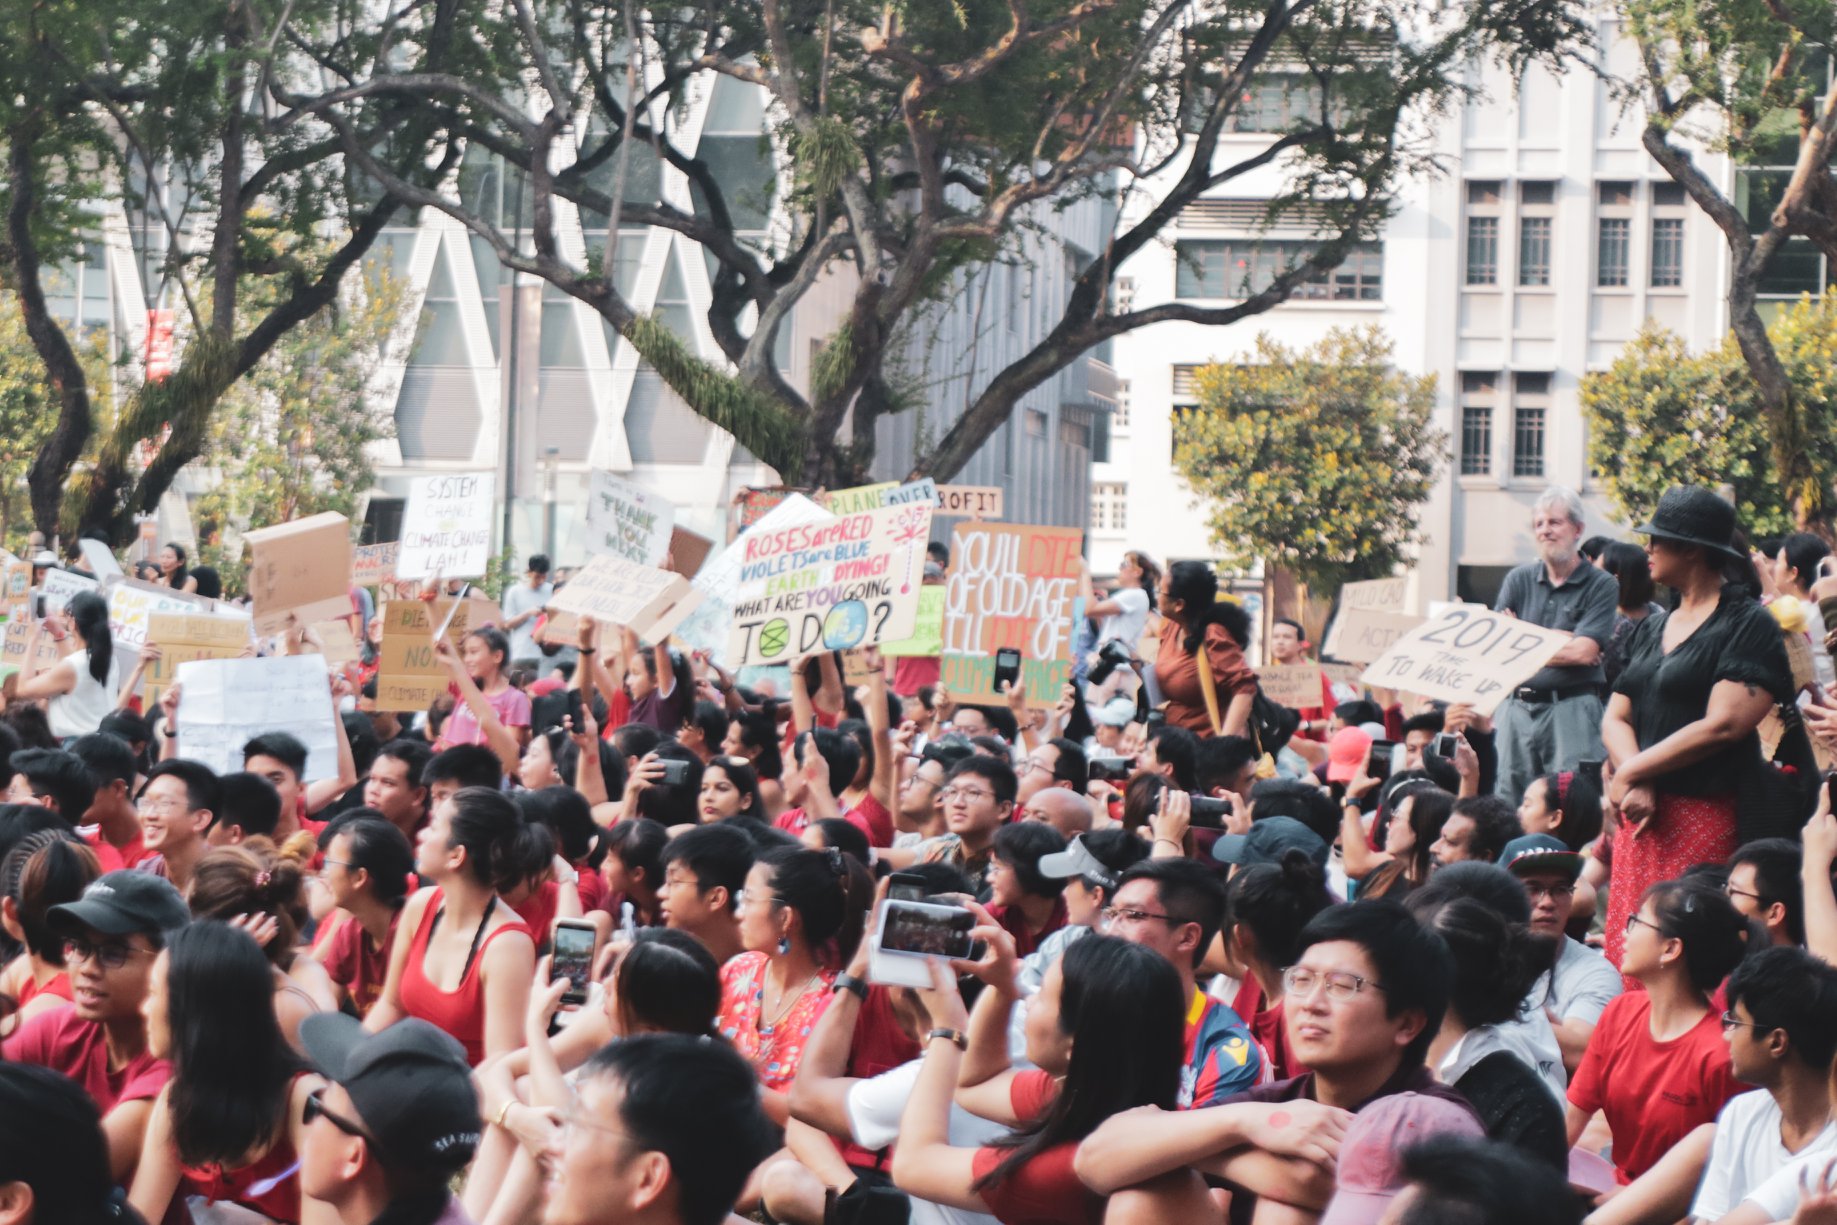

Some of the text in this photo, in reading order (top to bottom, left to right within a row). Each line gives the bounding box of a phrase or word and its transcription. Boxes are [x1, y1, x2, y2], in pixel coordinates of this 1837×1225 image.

[427, 476, 478, 499] SYSTEM
[938, 491, 998, 512] ROFIT
[425, 502, 473, 518] CHANGE
[600, 491, 658, 536] THANK
[405, 529, 488, 549] CLIMATE CHANGE
[605, 532, 648, 566] NEXT
[616, 517, 648, 549] YOU
[745, 525, 813, 562] ROSES
[812, 527, 843, 547] are
[838, 514, 874, 544] RED
[425, 550, 468, 571] LAH!
[741, 540, 872, 583] VIOLETS are BLUE
[767, 568, 818, 596] EARTH
[832, 553, 891, 583] DYING!
[1026, 534, 1083, 579] DIE
[734, 576, 893, 619] WHAT ARE YOU GOING
[946, 572, 978, 613] OF
[979, 573, 1029, 617] OLD
[1027, 576, 1078, 620] AGE
[1032, 617, 1072, 661] OF
[1358, 625, 1393, 648] ACT
[1418, 609, 1544, 666] 2019
[1387, 655, 1412, 676] TO
[1418, 664, 1474, 690] WAKE
[1474, 676, 1503, 695] UP
[1432, 650, 1468, 667] TIME
